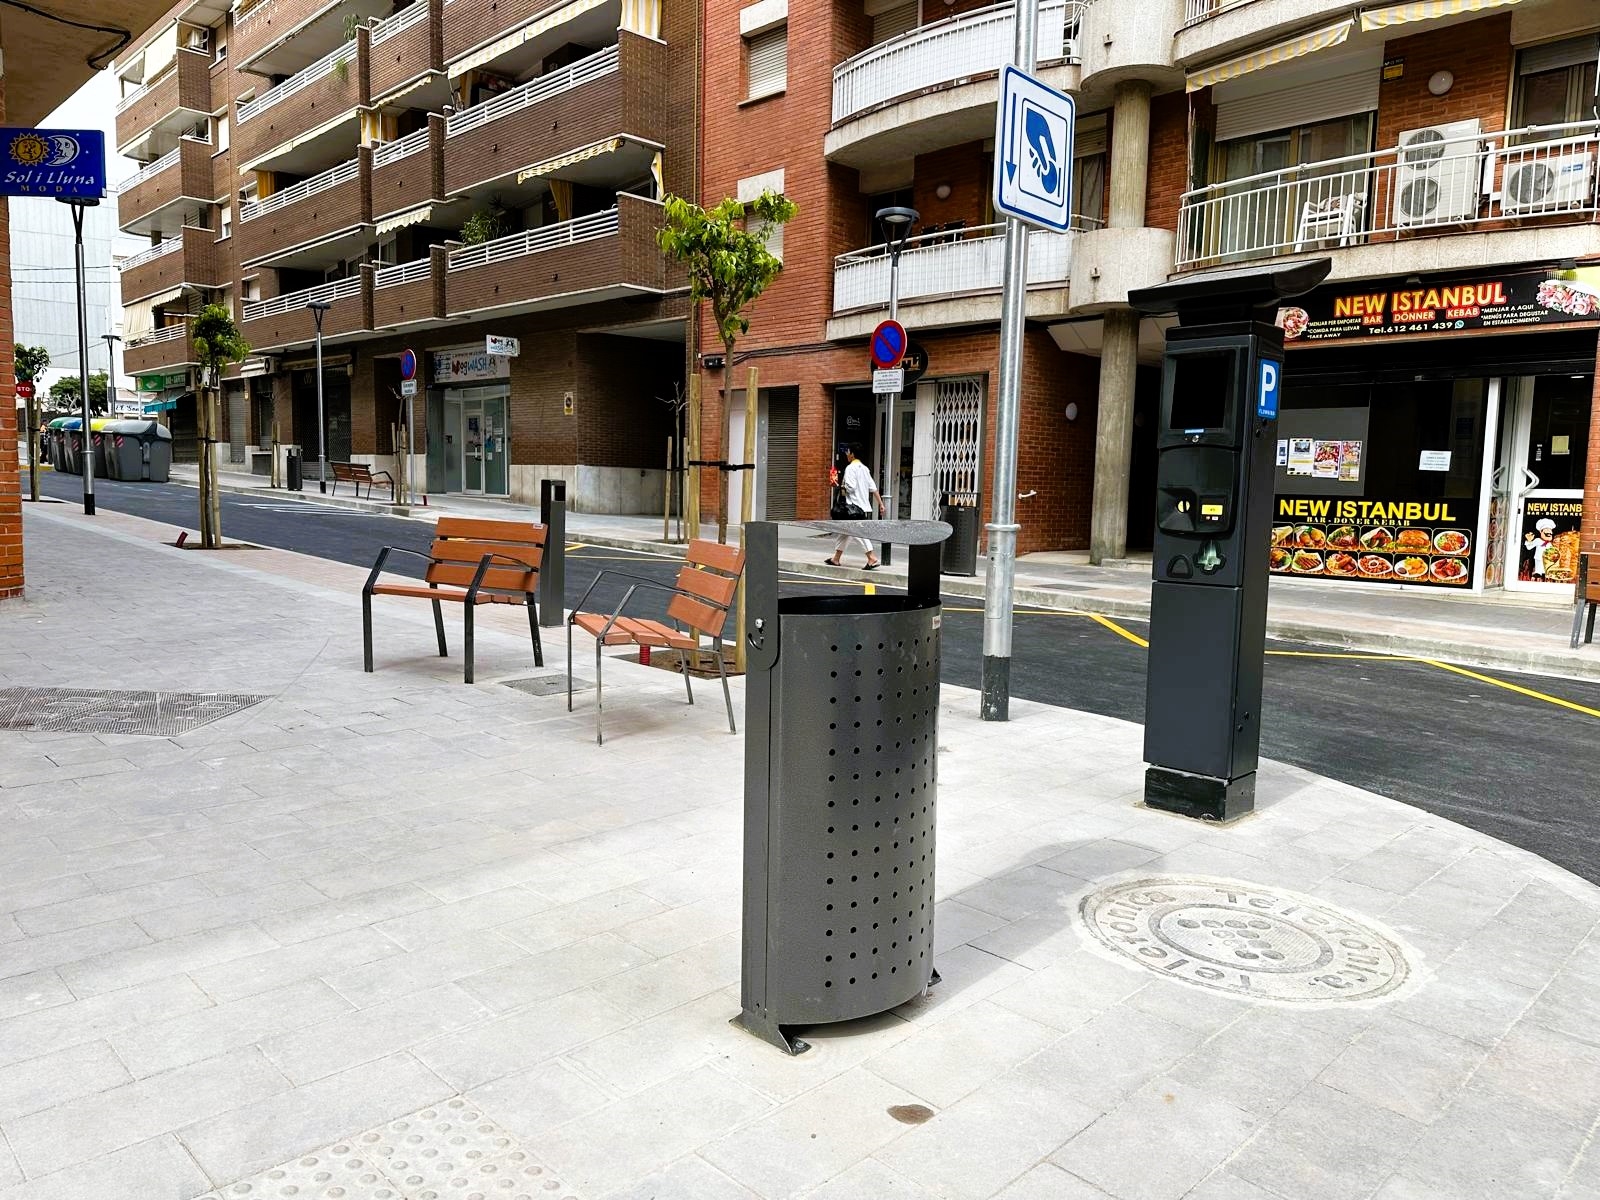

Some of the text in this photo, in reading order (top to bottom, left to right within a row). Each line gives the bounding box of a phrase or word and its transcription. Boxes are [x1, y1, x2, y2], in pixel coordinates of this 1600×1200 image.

[4, 170, 95, 185] Sol i Lluna
[20, 185, 78, 193] MODA
[1334, 282, 1506, 318] NEW ISTANBUL
[1363, 315, 1383, 325] BAR
[1447, 307, 1479, 318] KEBAB
[1432, 322, 1453, 330] 439
[1260, 363, 1276, 407] P
[1279, 499, 1457, 522] NEW ISTANBUL
[1527, 503, 1549, 512] NEW
[1333, 517, 1371, 525] DONER
[1372, 518, 1410, 526] KEBAB
